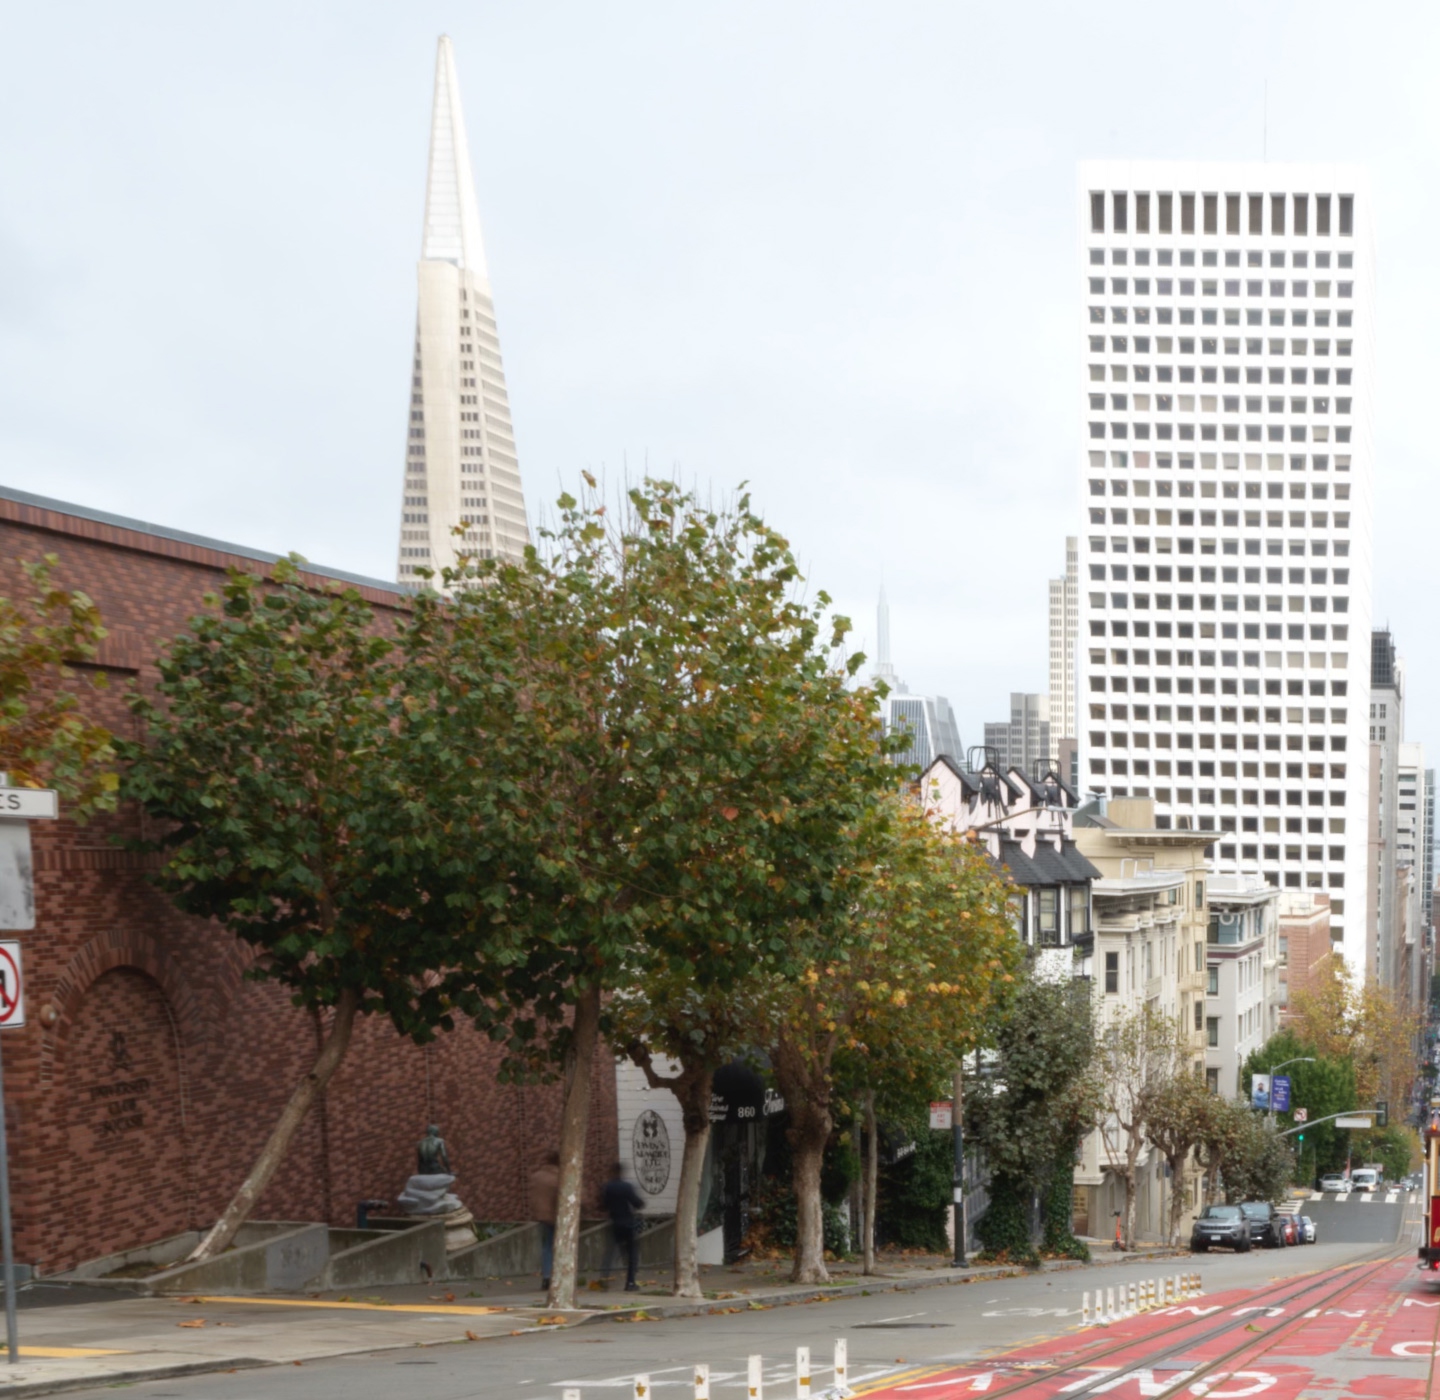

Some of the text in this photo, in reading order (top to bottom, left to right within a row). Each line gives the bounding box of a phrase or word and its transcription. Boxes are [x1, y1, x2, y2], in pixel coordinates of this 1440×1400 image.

[737, 1106, 756, 1118] 860
[1148, 1305, 1366, 1319] MUNI
[894, 1367, 1278, 1399] ONLY
